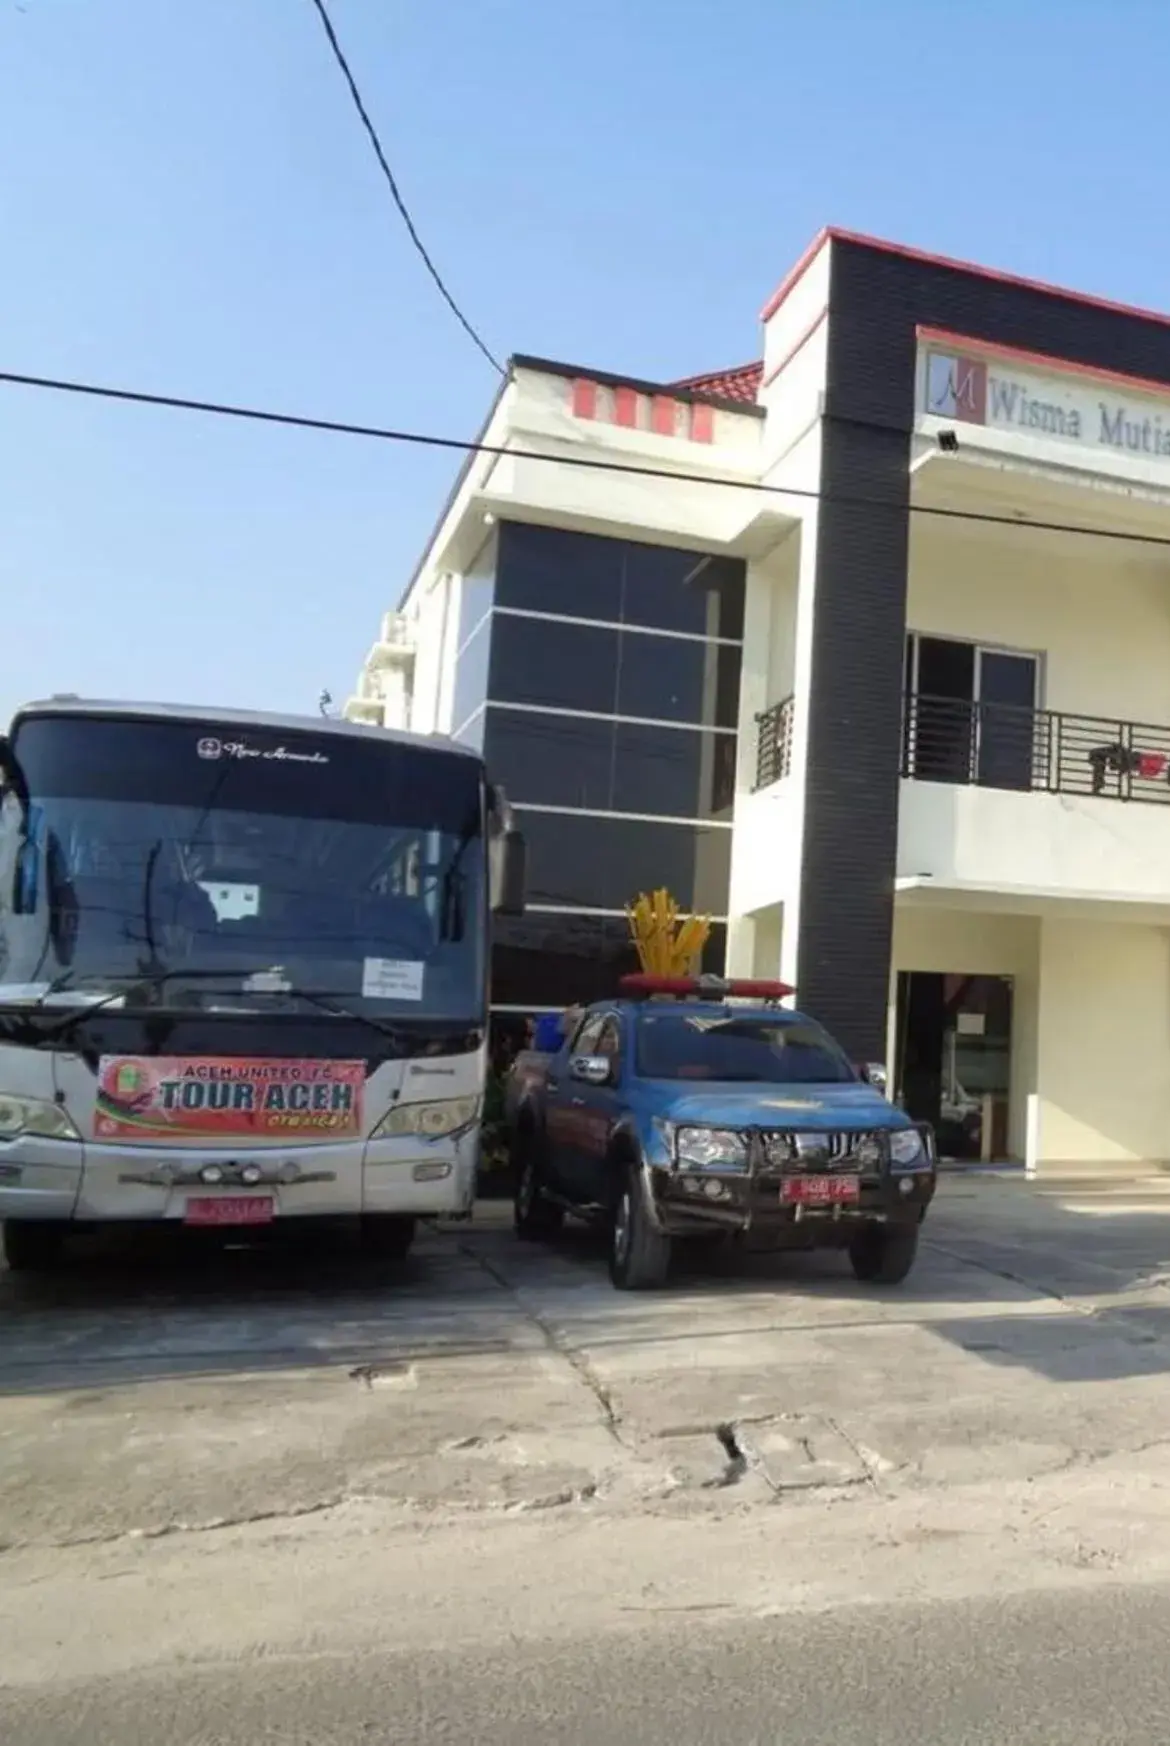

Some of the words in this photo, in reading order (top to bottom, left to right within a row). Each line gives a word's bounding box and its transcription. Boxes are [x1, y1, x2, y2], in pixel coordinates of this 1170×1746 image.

[989, 377, 1081, 438] Wisma
[184, 1065, 232, 1079] ACEH
[160, 1081, 254, 1110] TOUR
[264, 1082, 354, 1111] ACEH
